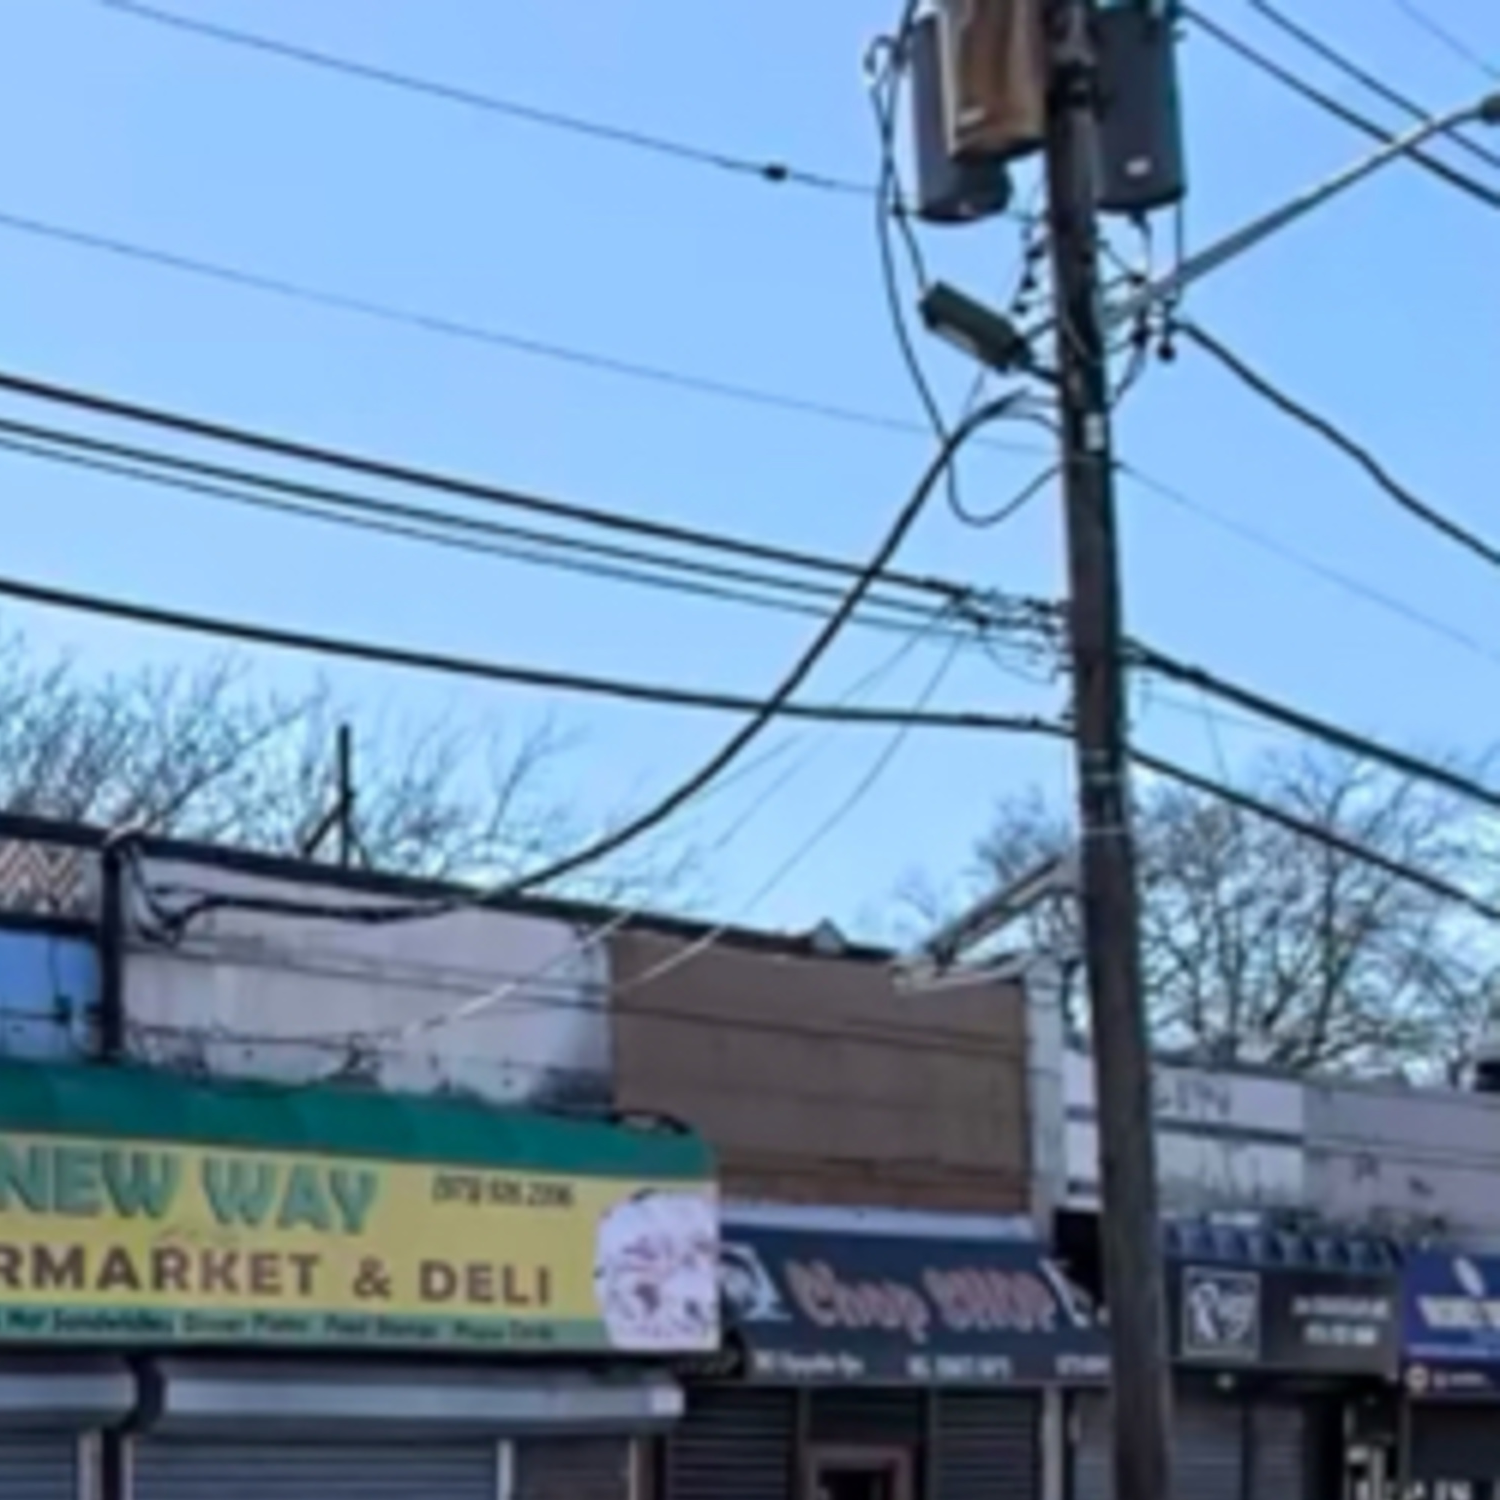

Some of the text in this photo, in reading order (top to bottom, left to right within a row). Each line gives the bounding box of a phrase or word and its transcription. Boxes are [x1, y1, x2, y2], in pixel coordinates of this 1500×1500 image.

[200, 1154, 381, 1236] WAY
[352, 1257, 393, 1299] &
[418, 1259, 552, 1307] DELI
